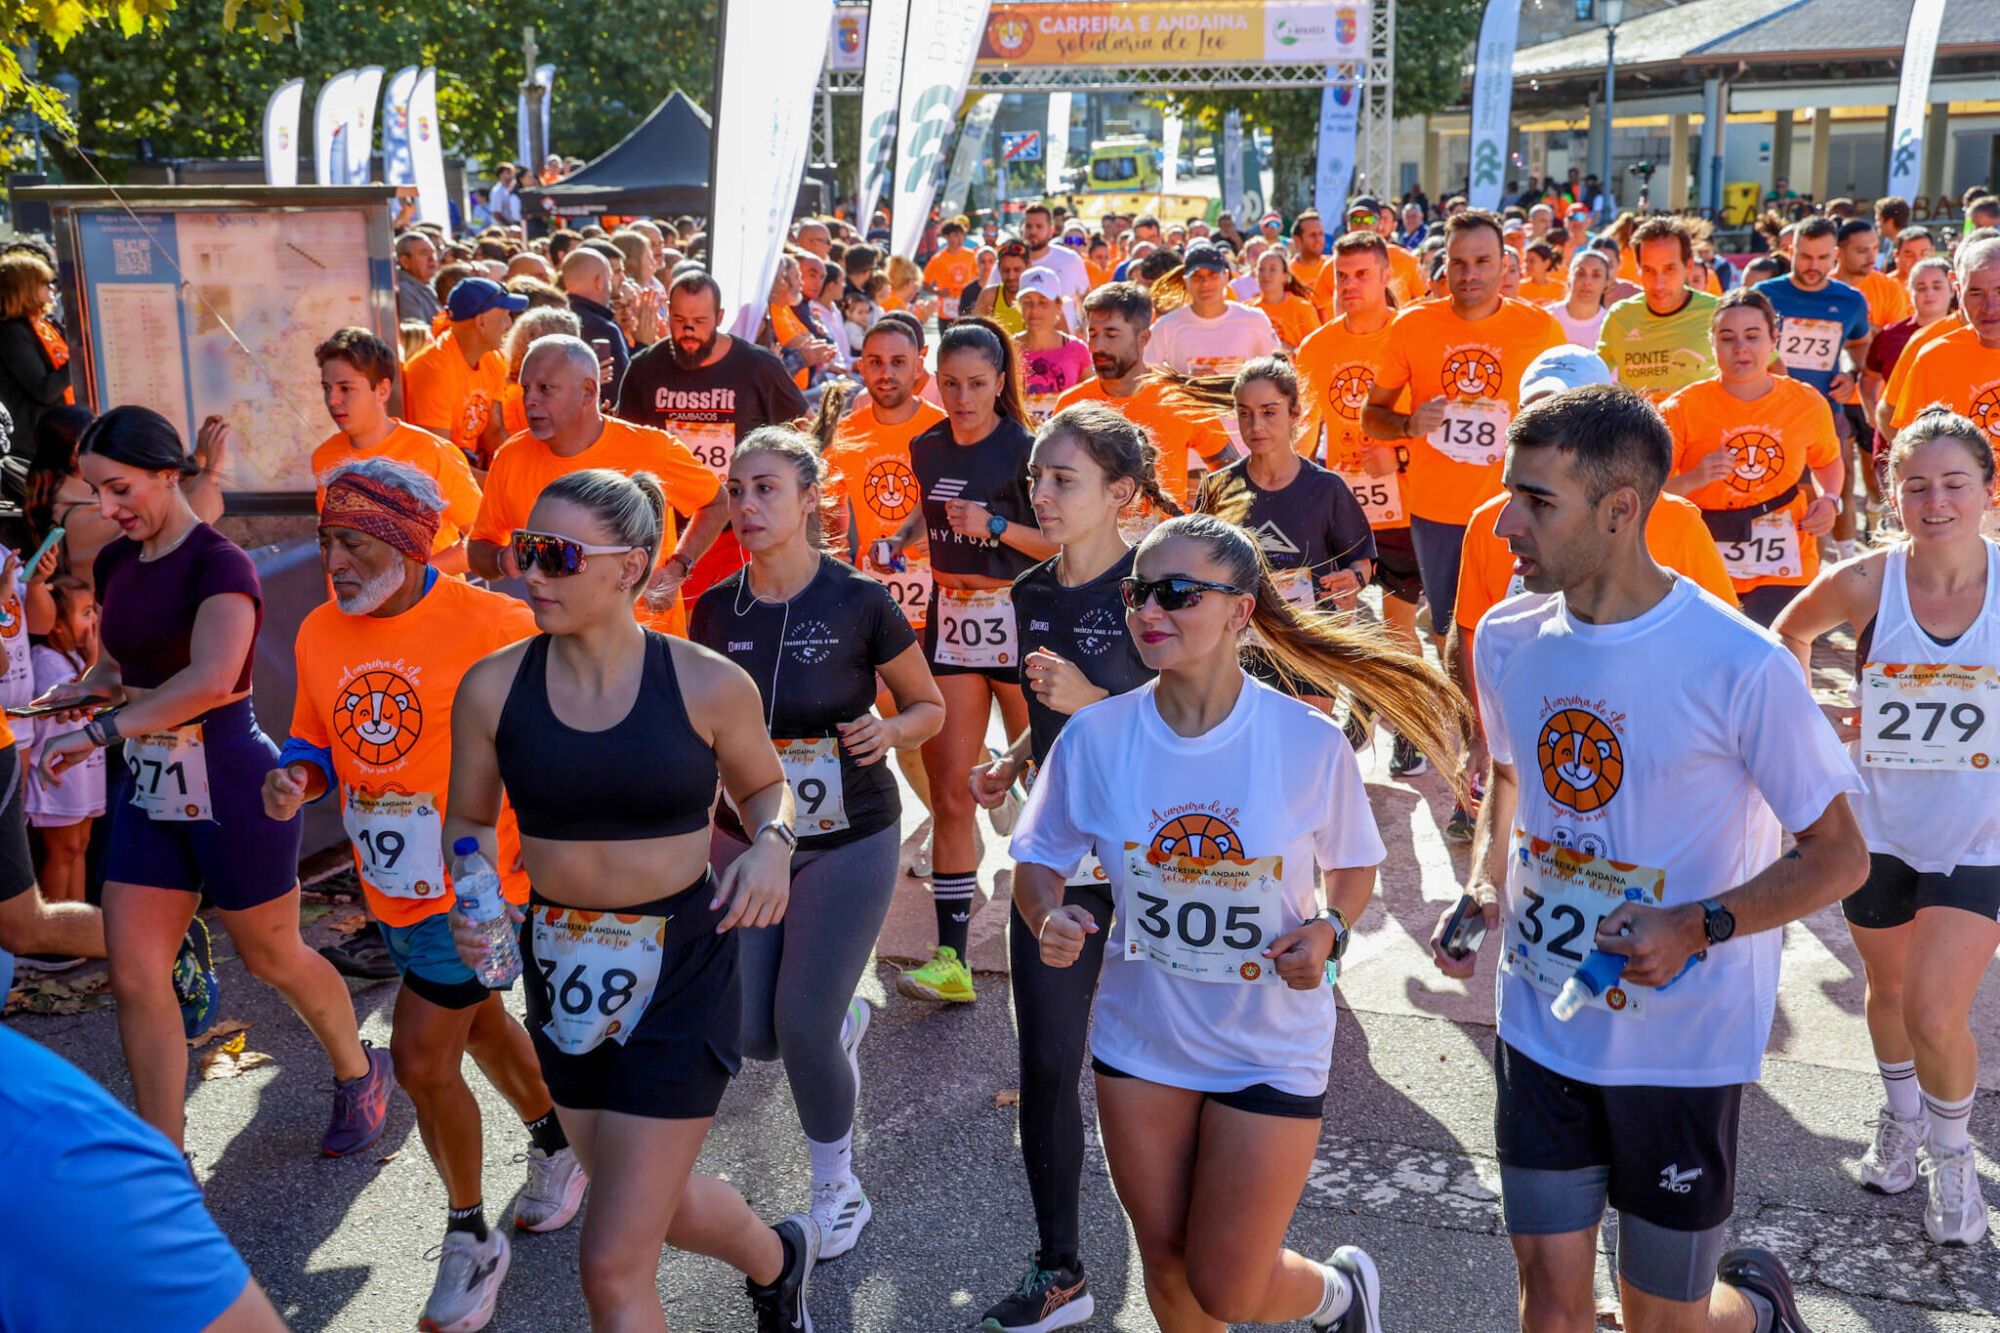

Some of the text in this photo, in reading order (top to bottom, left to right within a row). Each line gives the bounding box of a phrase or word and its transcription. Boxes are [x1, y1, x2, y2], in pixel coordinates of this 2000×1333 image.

[1039, 14, 1248, 35] CARREIRA E ANDAINA
[1056, 30, 1154, 57] solidaria
[1162, 28, 1187, 49] de
[1625, 350, 1669, 365] PONTE
[1786, 336, 1831, 357] 273
[1626, 366, 1669, 378] CORRER
[655, 387, 736, 409] CrossFit
[669, 412, 718, 421] CAMBADOS
[1440, 418, 1496, 447] 138
[1723, 537, 1786, 563] 315
[944, 616, 1007, 647] 203
[1878, 701, 1985, 743] 279
[129, 755, 188, 795] 271
[358, 828, 406, 869] 19
[1161, 863, 1202, 875] CARREIRA
[1211, 870, 1250, 878] ANDAINA
[1541, 855, 1577, 873] CARREIRA
[1585, 870, 1626, 885] ANDAINA
[594, 926, 632, 937] ANDAINA
[1137, 891, 1262, 950] 305
[1518, 886, 1604, 962] 32
[537, 958, 638, 1016] 368
